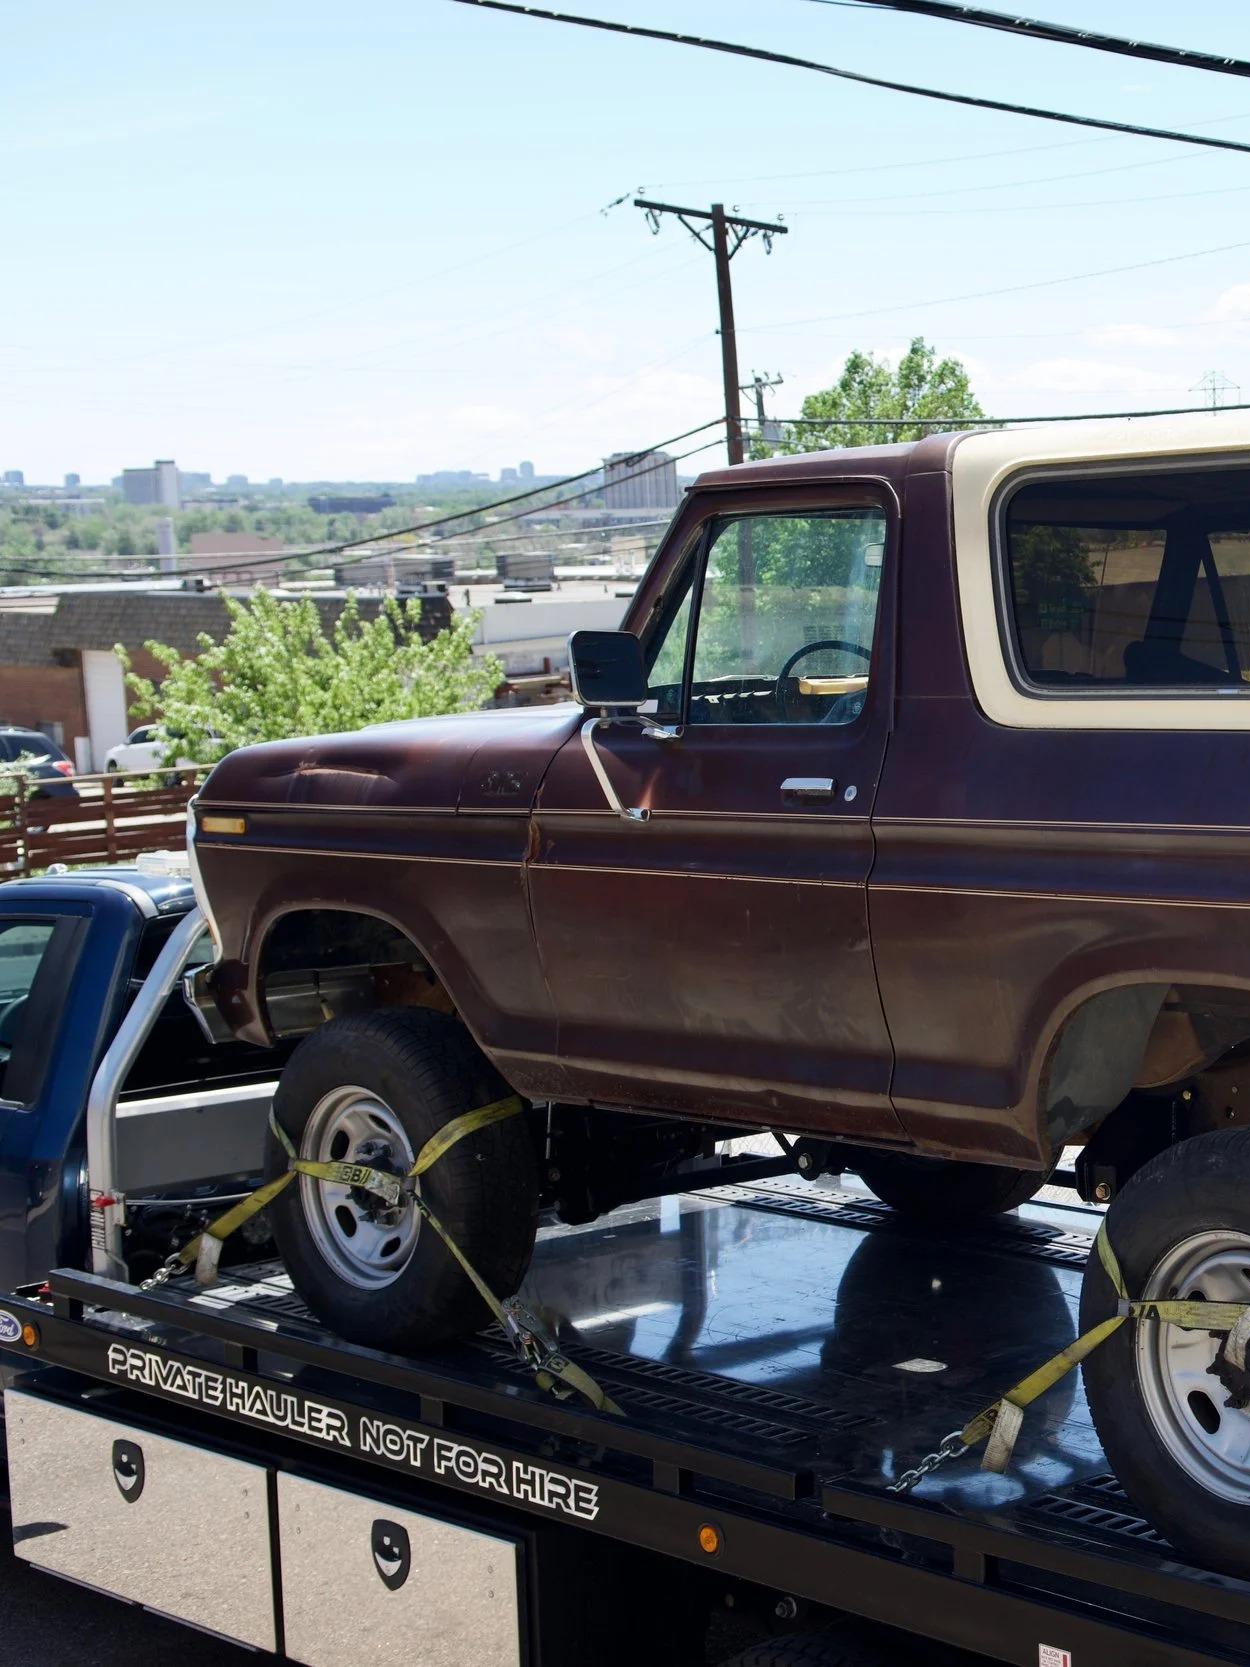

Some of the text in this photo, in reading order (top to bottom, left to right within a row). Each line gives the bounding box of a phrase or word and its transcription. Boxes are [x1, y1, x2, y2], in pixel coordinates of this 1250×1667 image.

[108, 1343, 600, 1521] PRIVATE HAULER NOT FOR HIRE
